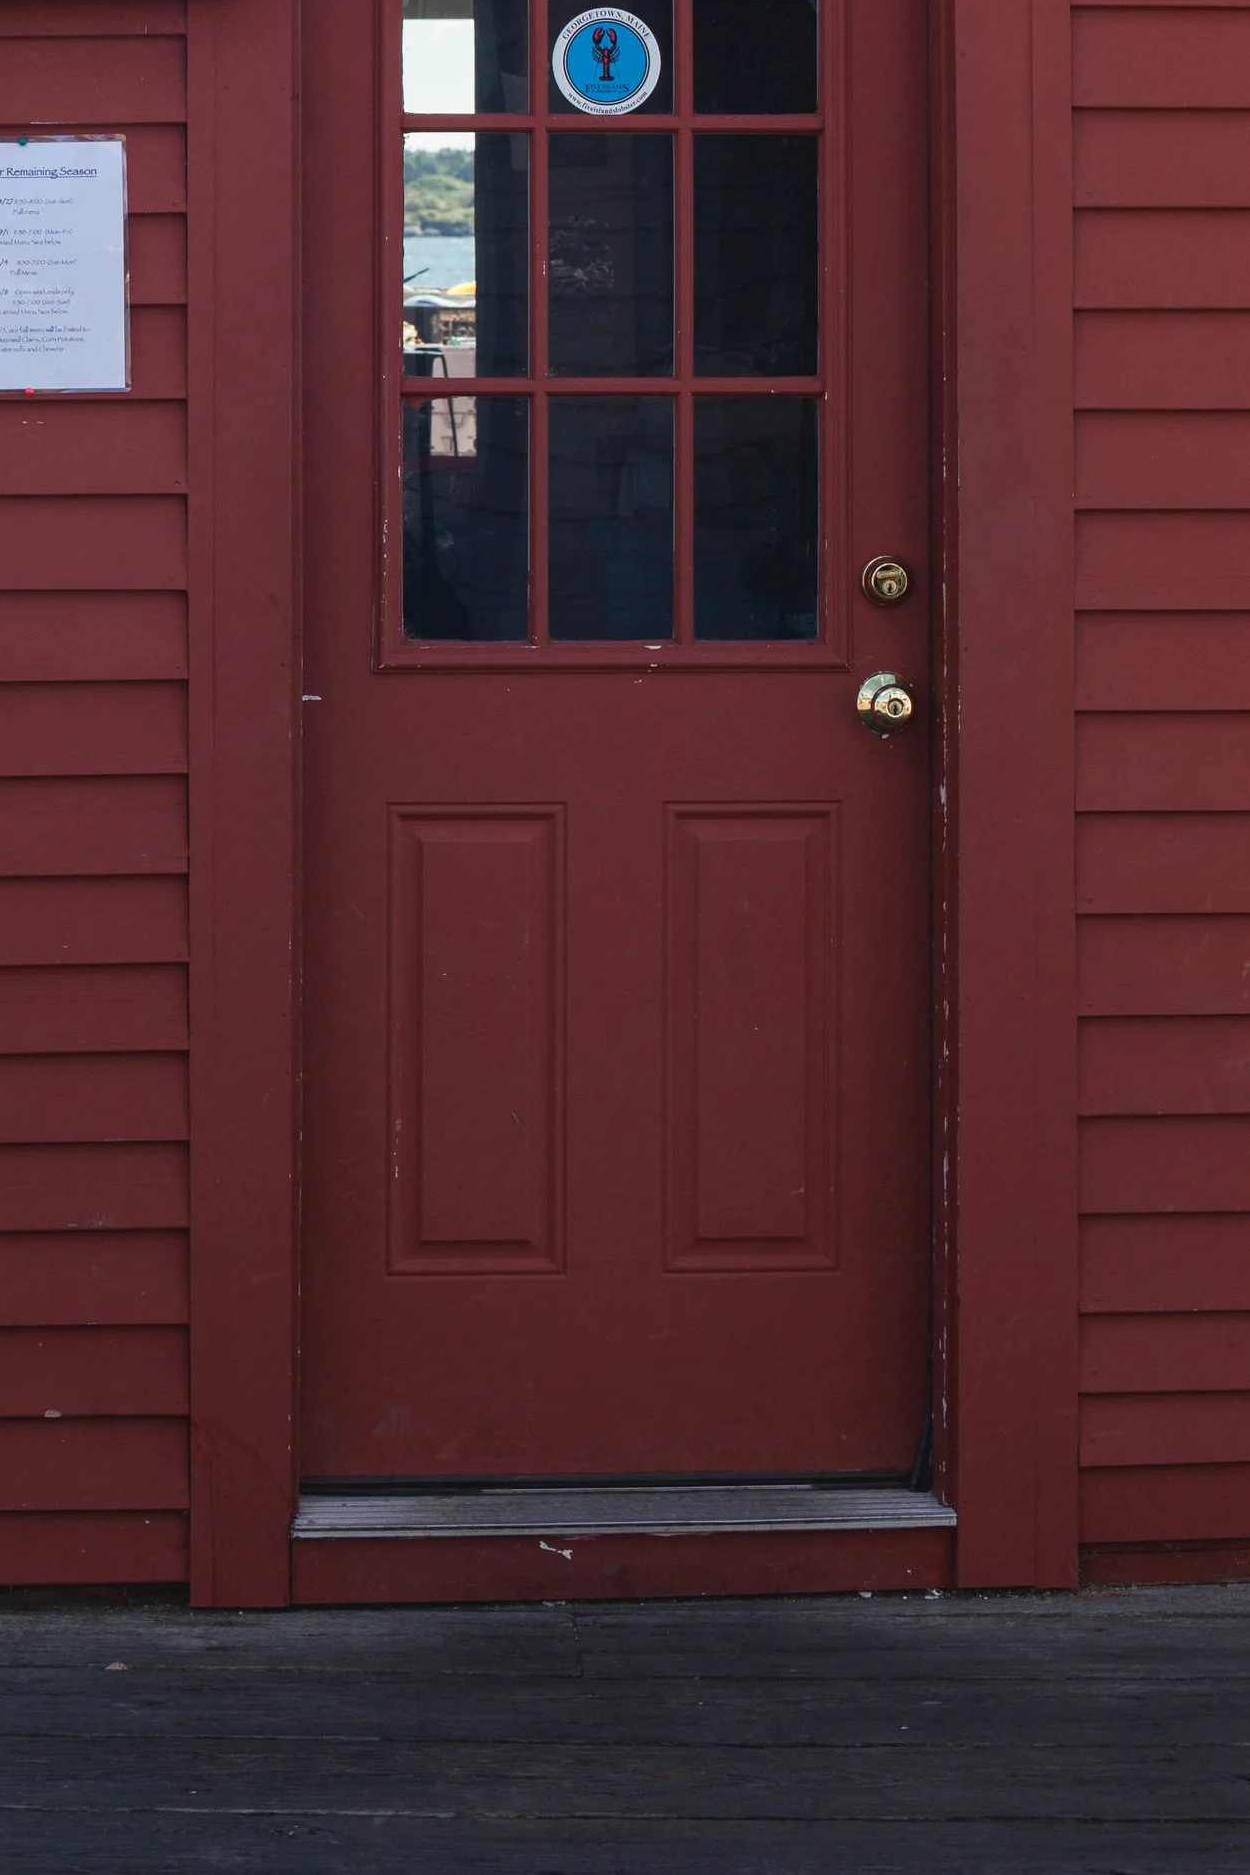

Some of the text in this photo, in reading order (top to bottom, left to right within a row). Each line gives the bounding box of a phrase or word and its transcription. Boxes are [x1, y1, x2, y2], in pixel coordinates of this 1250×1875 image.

[562, 10, 652, 40] GEORGETOWN, MAINE
[602, 84, 630, 92] ISLANDS
[567, 91, 648, 114] www.fiveislandslobster.com
[6, 167, 58, 179] Remaining
[59, 167, 97, 176] Season
